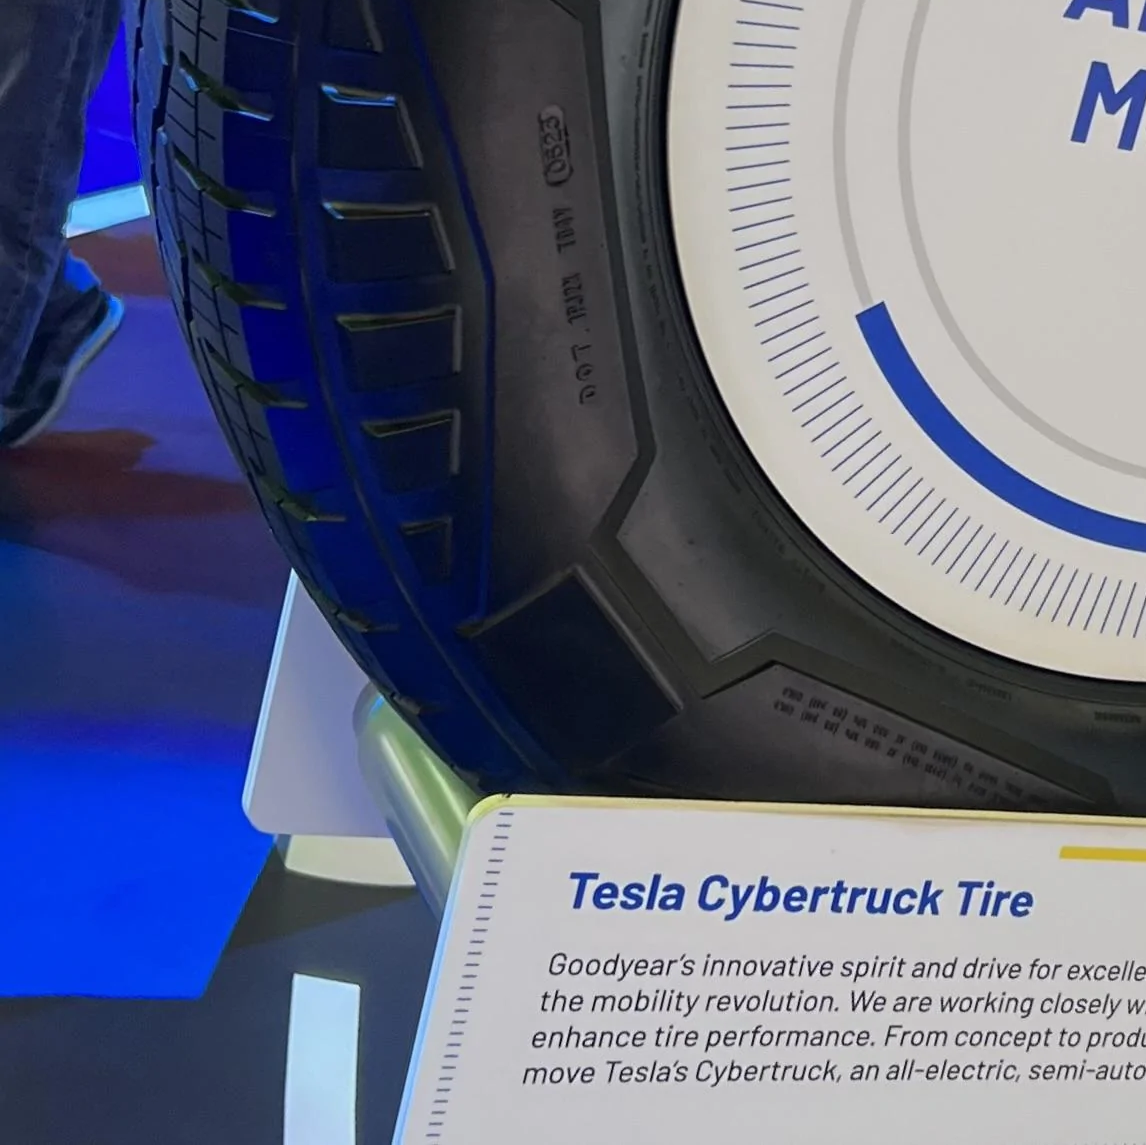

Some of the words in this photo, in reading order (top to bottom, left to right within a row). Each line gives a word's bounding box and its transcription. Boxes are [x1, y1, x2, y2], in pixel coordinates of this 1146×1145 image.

[568, 871, 687, 912] Tesla
[698, 874, 944, 922] Cybertruck
[957, 880, 1035, 918] Tire
[549, 953, 695, 981] Goodyear's
[703, 954, 833, 977] innovative
[841, 956, 906, 982] spirit
[912, 958, 957, 978] and
[963, 958, 1021, 979] drive
[1030, 959, 1062, 979] for
[541, 990, 583, 1011] the
[592, 990, 699, 1017] mobility
[706, 990, 838, 1011] revolution.
[852, 991, 886, 1012] We
[893, 997, 932, 1012] are
[941, 992, 1034, 1018] working
[1041, 993, 1121, 1019] closely
[532, 1026, 646, 1048] enhance
[655, 1025, 698, 1047] tire
[705, 1025, 874, 1052] performance.
[885, 1025, 947, 1046] From
[955, 1028, 1052, 1052] concept
[1059, 1028, 1081, 1048] to
[523, 1067, 595, 1084] move
[607, 1061, 688, 1082] Tesla's
[696, 1060, 841, 1087] Cybertruck,
[850, 1064, 880, 1081] an
[886, 1060, 1020, 1085] all-electric,
